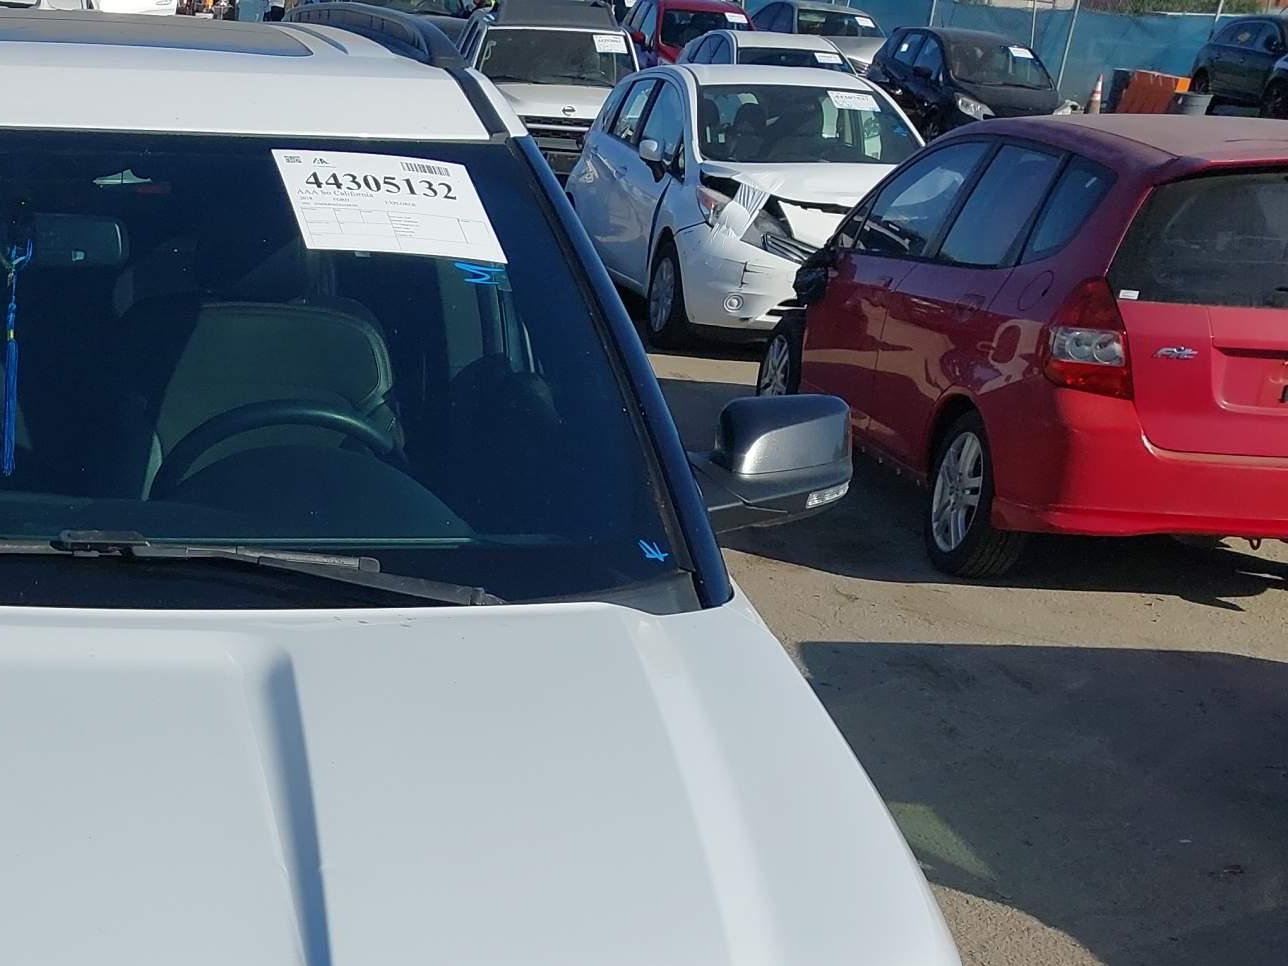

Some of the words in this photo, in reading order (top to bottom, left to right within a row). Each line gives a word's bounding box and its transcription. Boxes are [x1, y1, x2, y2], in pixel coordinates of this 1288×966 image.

[297, 188, 318, 196] AAA
[333, 189, 374, 198] California
[305, 170, 457, 201] 44305132
